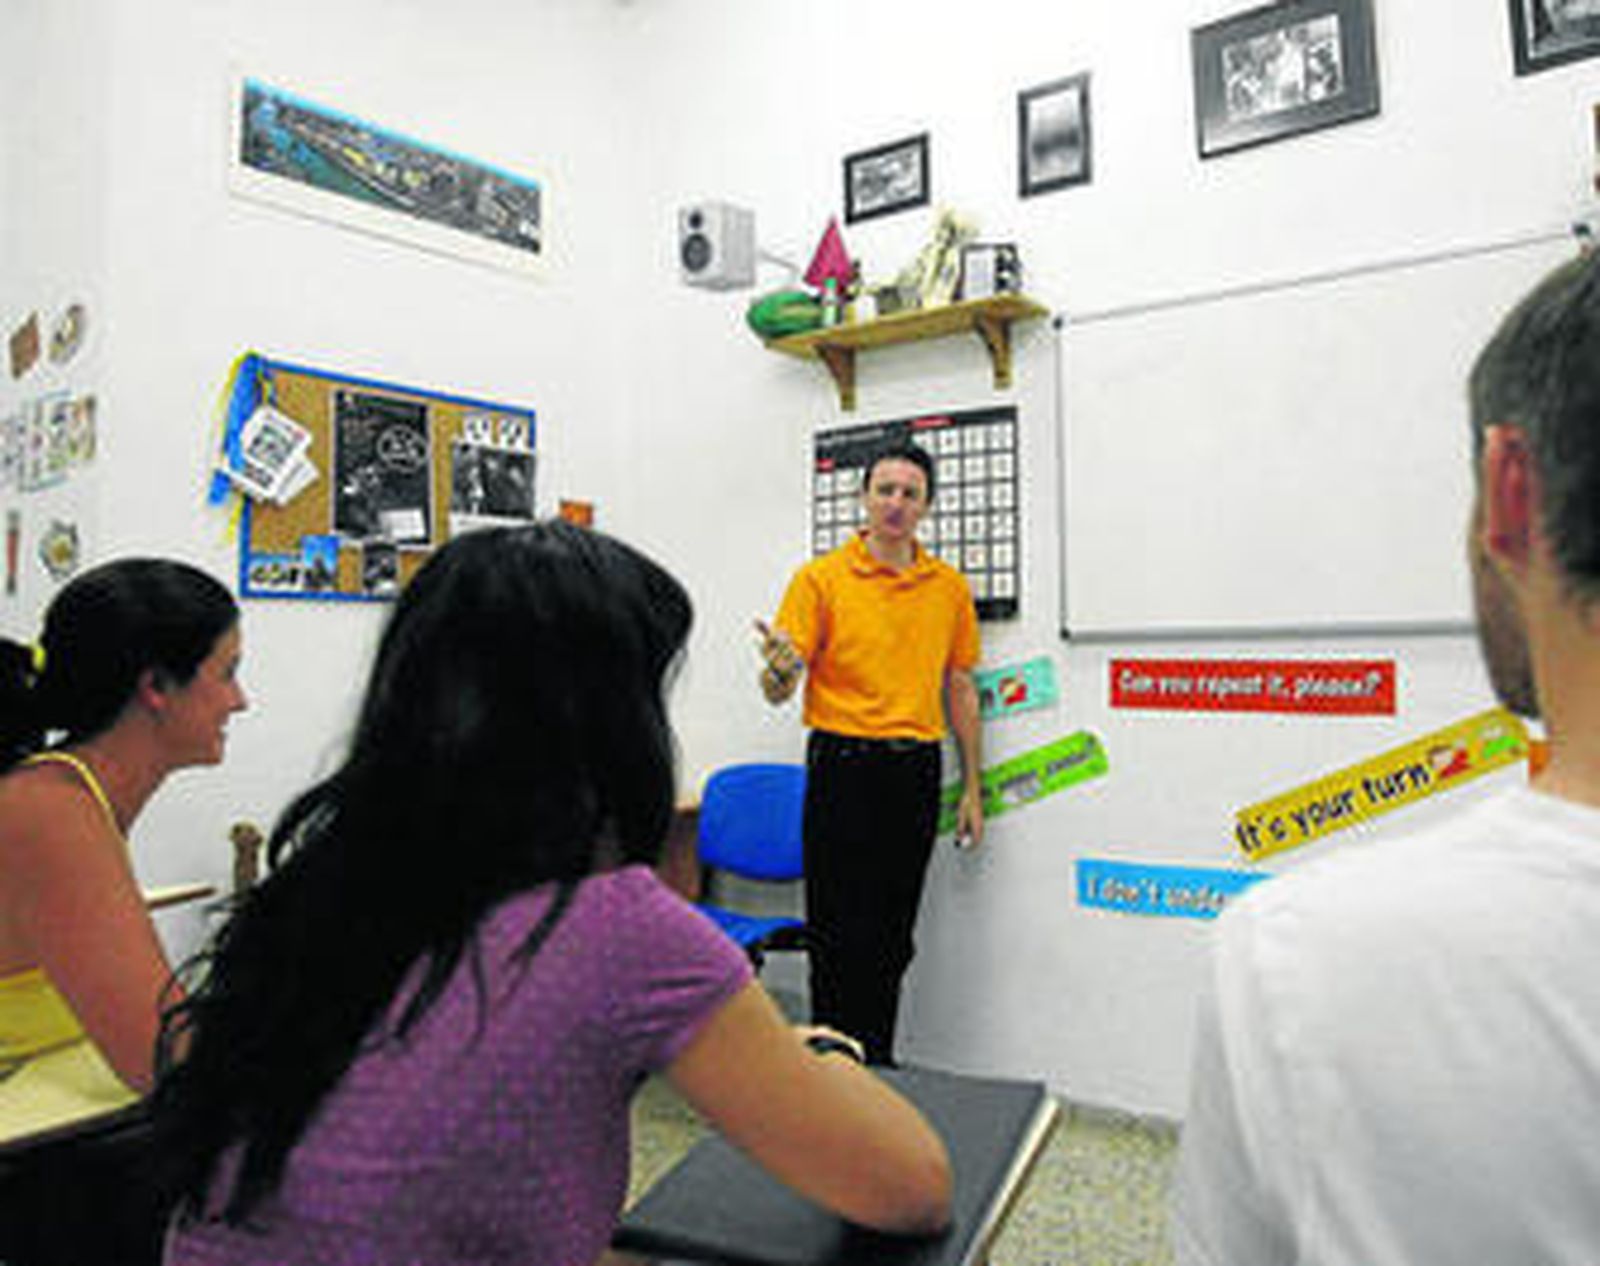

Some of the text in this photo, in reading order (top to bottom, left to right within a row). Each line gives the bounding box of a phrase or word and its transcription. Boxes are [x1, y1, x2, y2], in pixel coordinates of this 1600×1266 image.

[1119, 668, 1152, 692] Can
[1160, 676, 1193, 697] you
[1199, 675, 1262, 700] repeat
[1293, 671, 1382, 701] please?
[1236, 763, 1431, 854] It's your turn
[1087, 878, 1099, 899] I
[1103, 878, 1161, 905] don't
